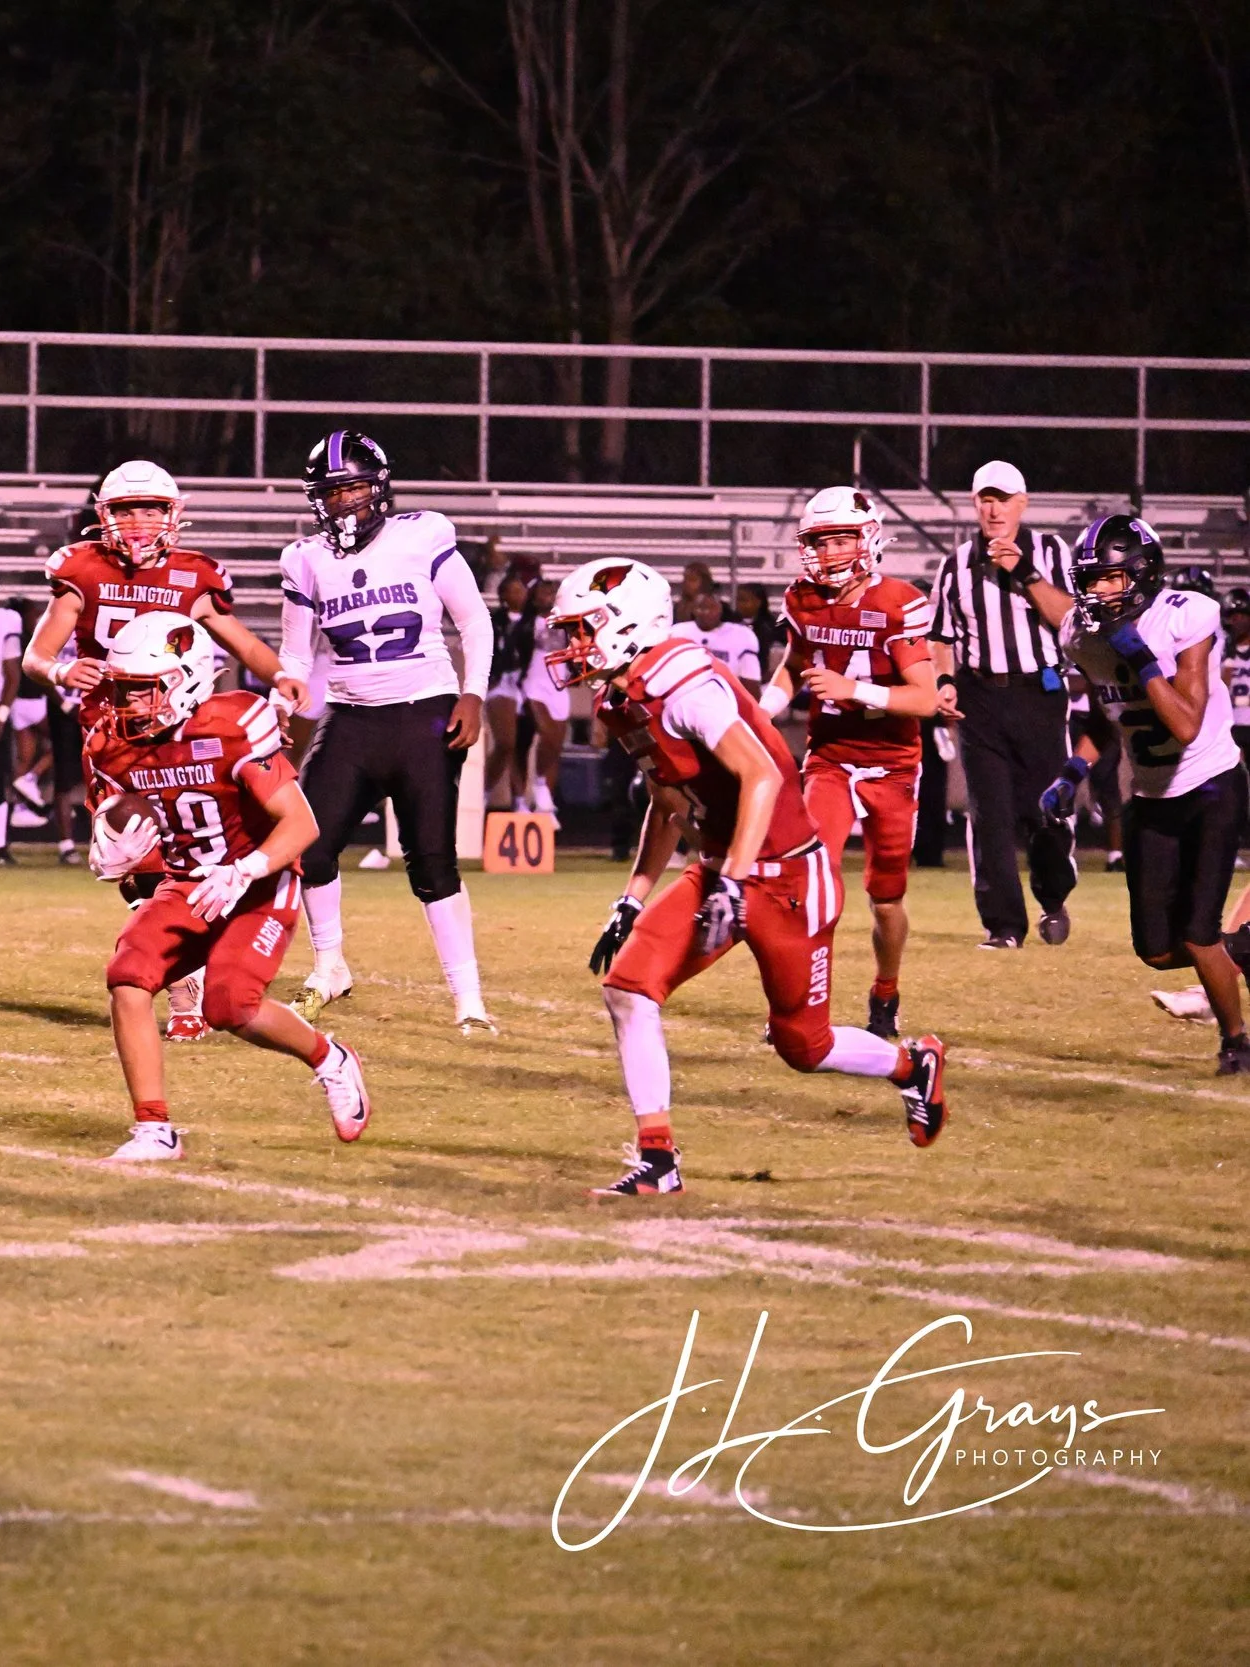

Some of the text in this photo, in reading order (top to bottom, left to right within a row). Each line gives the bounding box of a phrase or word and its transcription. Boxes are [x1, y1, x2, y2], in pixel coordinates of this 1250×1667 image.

[99, 583, 183, 607] MILLINGTON
[319, 582, 419, 621] PHARAOHS
[1166, 594, 1189, 609] 2
[321, 611, 426, 666] 52
[129, 763, 216, 790] MILLINGTON
[147, 791, 229, 868] 19
[498, 821, 543, 867] 40
[252, 916, 285, 958] CARDS
[807, 946, 829, 1007] CARDS
